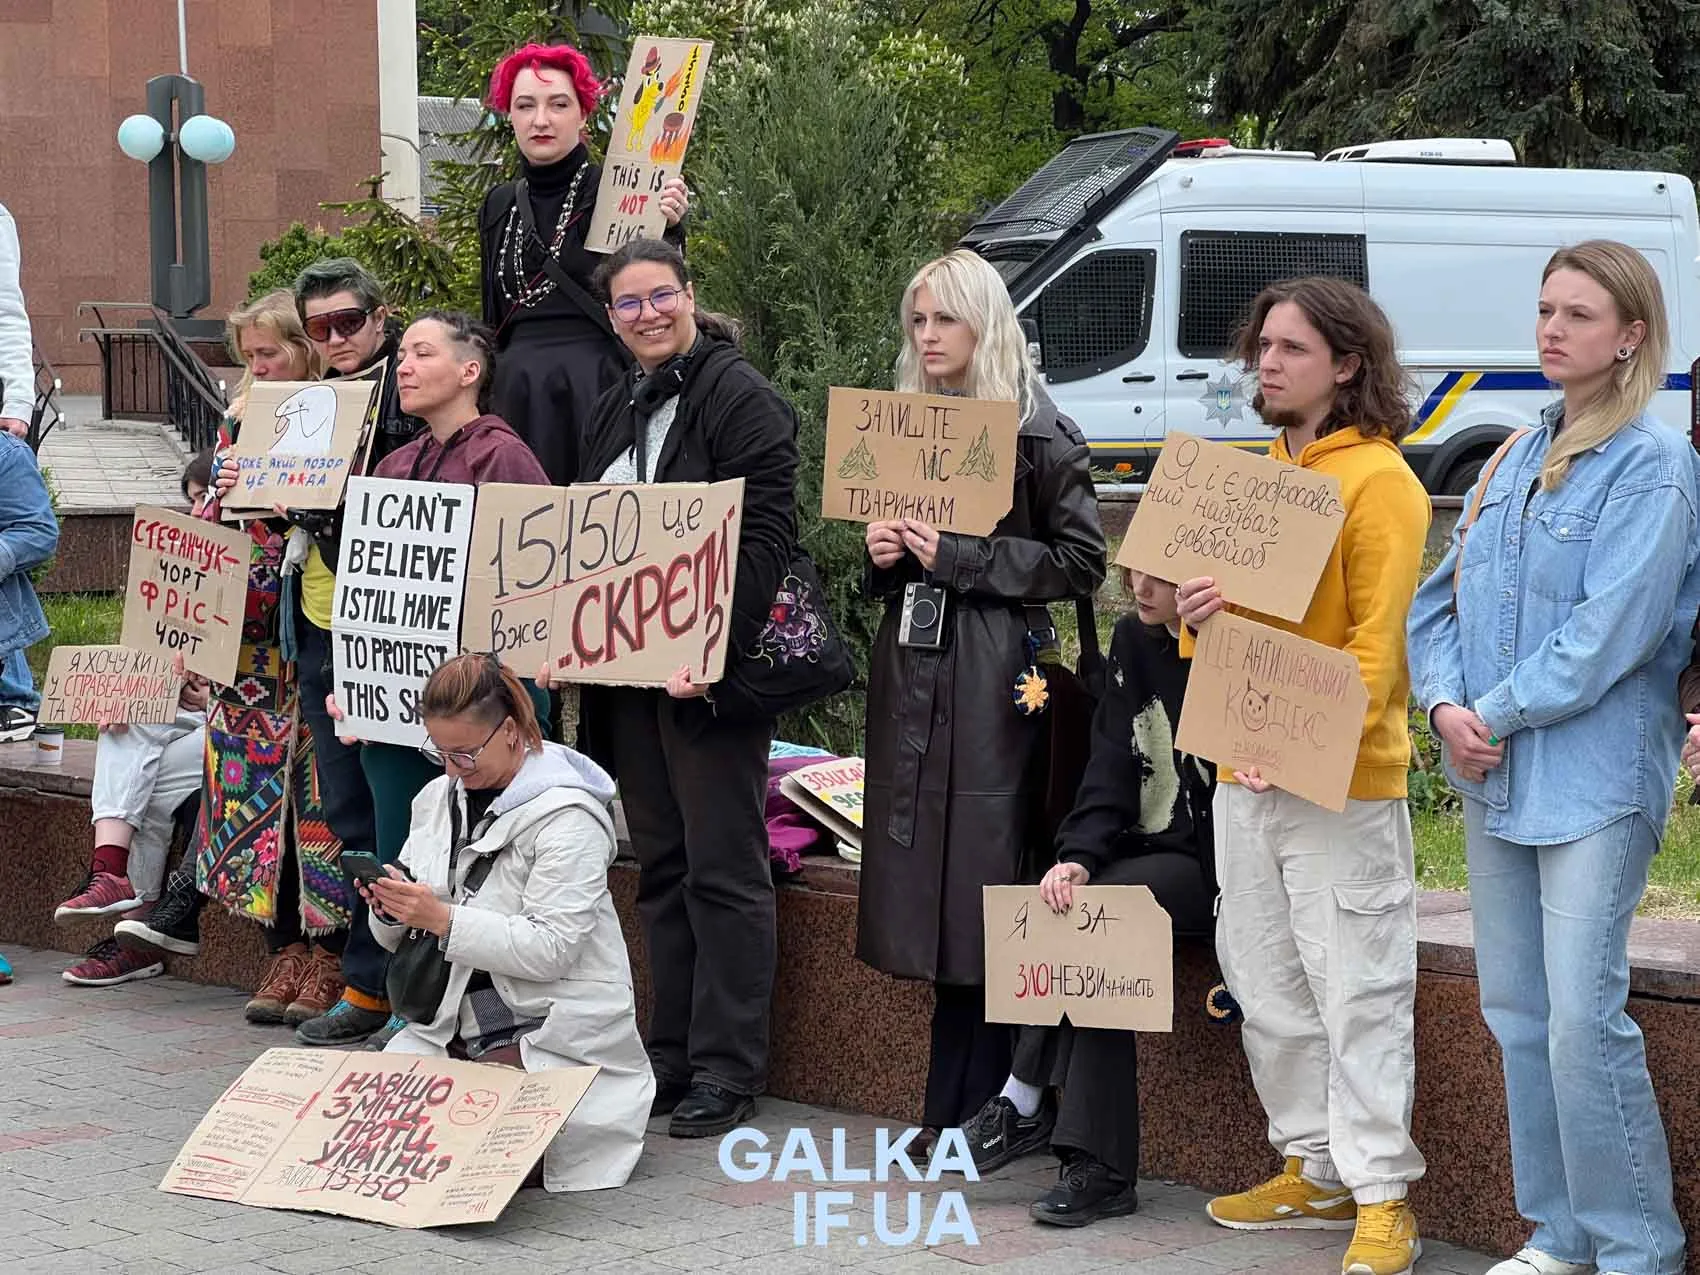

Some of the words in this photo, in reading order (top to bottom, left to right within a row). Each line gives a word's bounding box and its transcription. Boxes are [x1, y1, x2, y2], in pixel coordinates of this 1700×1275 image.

[618, 194, 649, 216] NOT
[855, 399, 961, 440] ЗАЛИШТЕ
[246, 472, 268, 490] ЦЕ
[303, 457, 344, 470] ПОЗОР
[1162, 439, 1200, 489] Я
[360, 492, 370, 526] I
[377, 492, 461, 533] CAN'T
[844, 487, 955, 525] ТВАРИНКАМ
[1146, 483, 1185, 506] ний
[1191, 495, 1280, 538] набувач
[348, 538, 457, 583] BELIEVE
[489, 489, 642, 599] 15150
[662, 497, 704, 538] це
[159, 558, 207, 592] ЧОРТ
[349, 586, 398, 626] STILL
[401, 591, 452, 631] HAVE
[156, 620, 203, 655] ЧОРТ
[491, 608, 549, 654] вже
[1204, 623, 1241, 677] ЦЕ
[67, 651, 82, 673] Я
[84, 649, 130, 674] ХОЧУ
[341, 633, 368, 670] TO
[371, 636, 448, 679] PROTEST
[48, 675, 60, 697] У
[342, 680, 390, 722] THIS
[48, 697, 65, 721] ТА
[127, 697, 170, 723] КРАЇНІ
[1002, 901, 1029, 942] Я
[1077, 902, 1122, 937] ЗА
[320, 1168, 410, 1202] 15150
